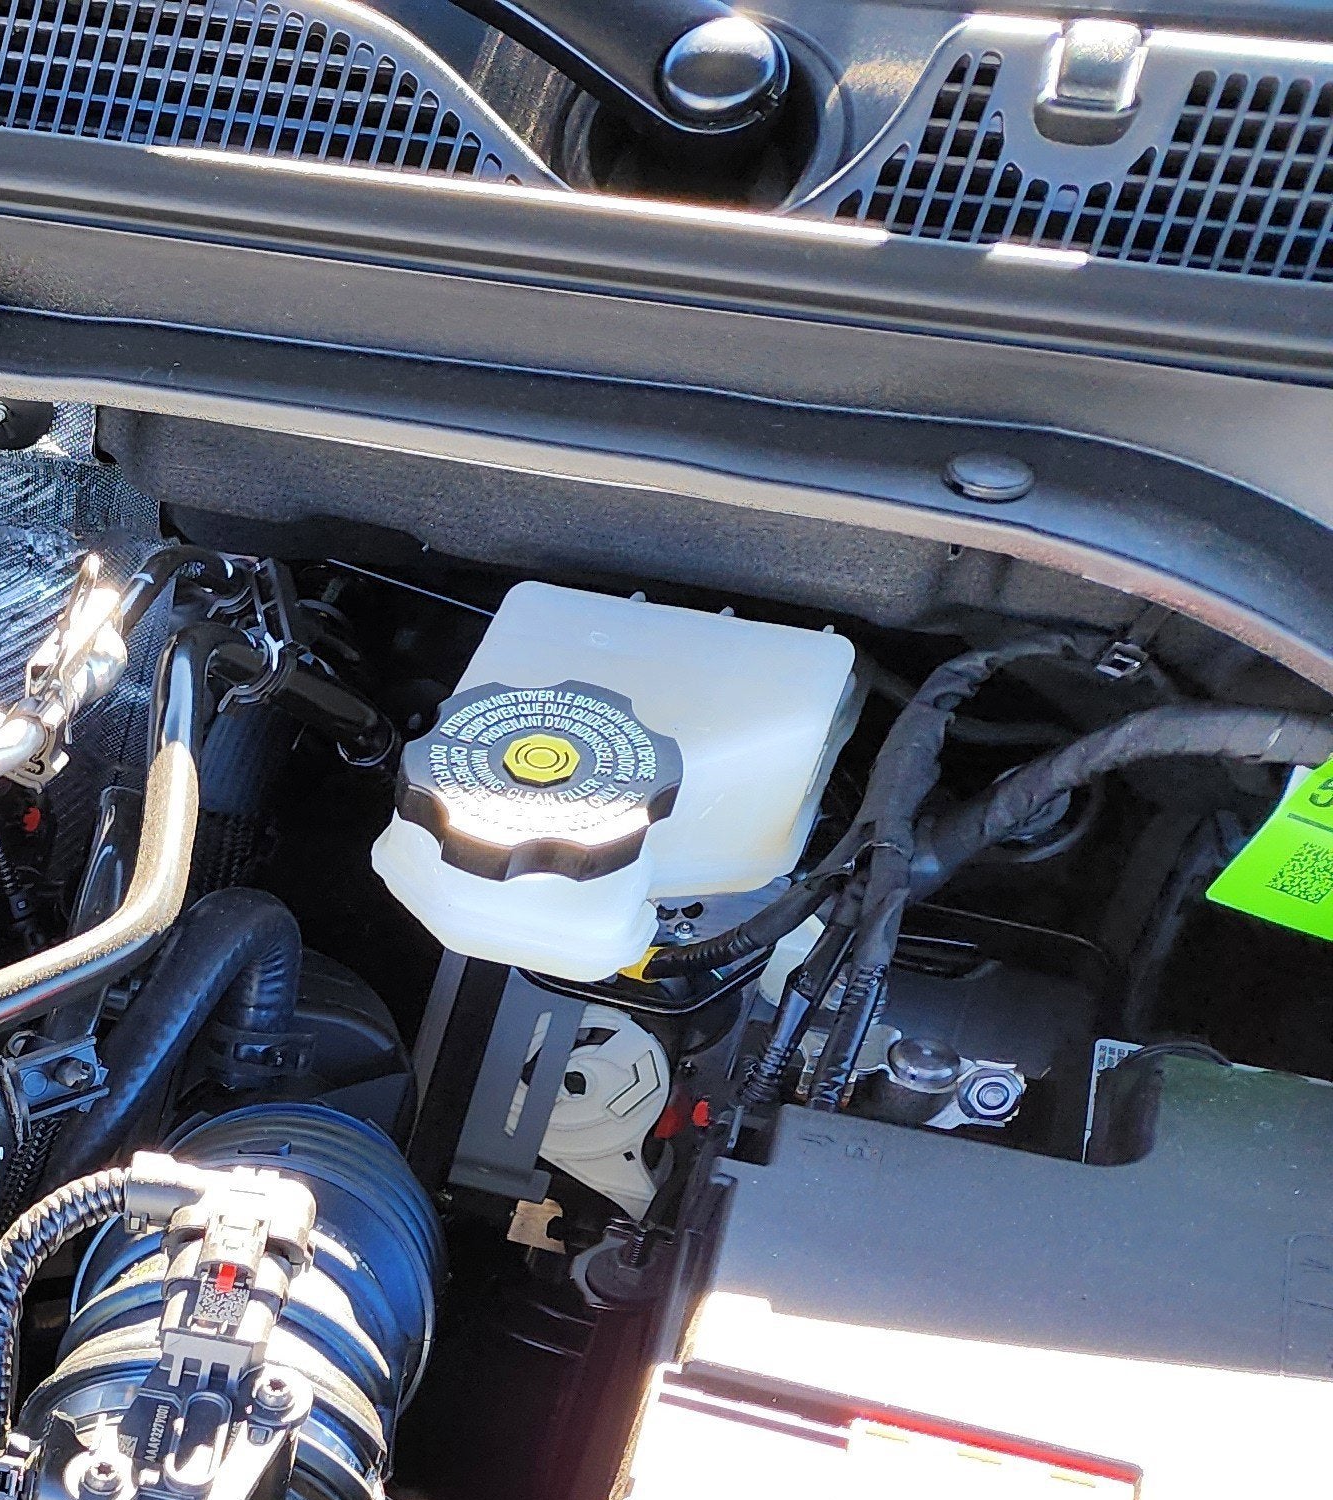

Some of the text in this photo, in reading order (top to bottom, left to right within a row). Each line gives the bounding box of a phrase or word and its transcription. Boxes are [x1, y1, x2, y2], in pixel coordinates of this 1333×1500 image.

[479, 716, 613, 776] PROVENANT D'UN BIDON SCELLE
[492, 690, 554, 707] NETTOYER
[556, 691, 574, 703] LE
[574, 694, 628, 724] BOUCHON
[621, 720, 652, 747] AVANT
[519, 703, 543, 714] QUE
[544, 703, 562, 716] DU
[563, 705, 606, 729] LIQUIDE
[600, 723, 618, 738] DE
[609, 733, 633, 759] FREIN
[450, 746, 468, 766] CAP
[471, 749, 603, 804] WARNING: CLEAN FILLER
[587, 784, 620, 808] ONLY
